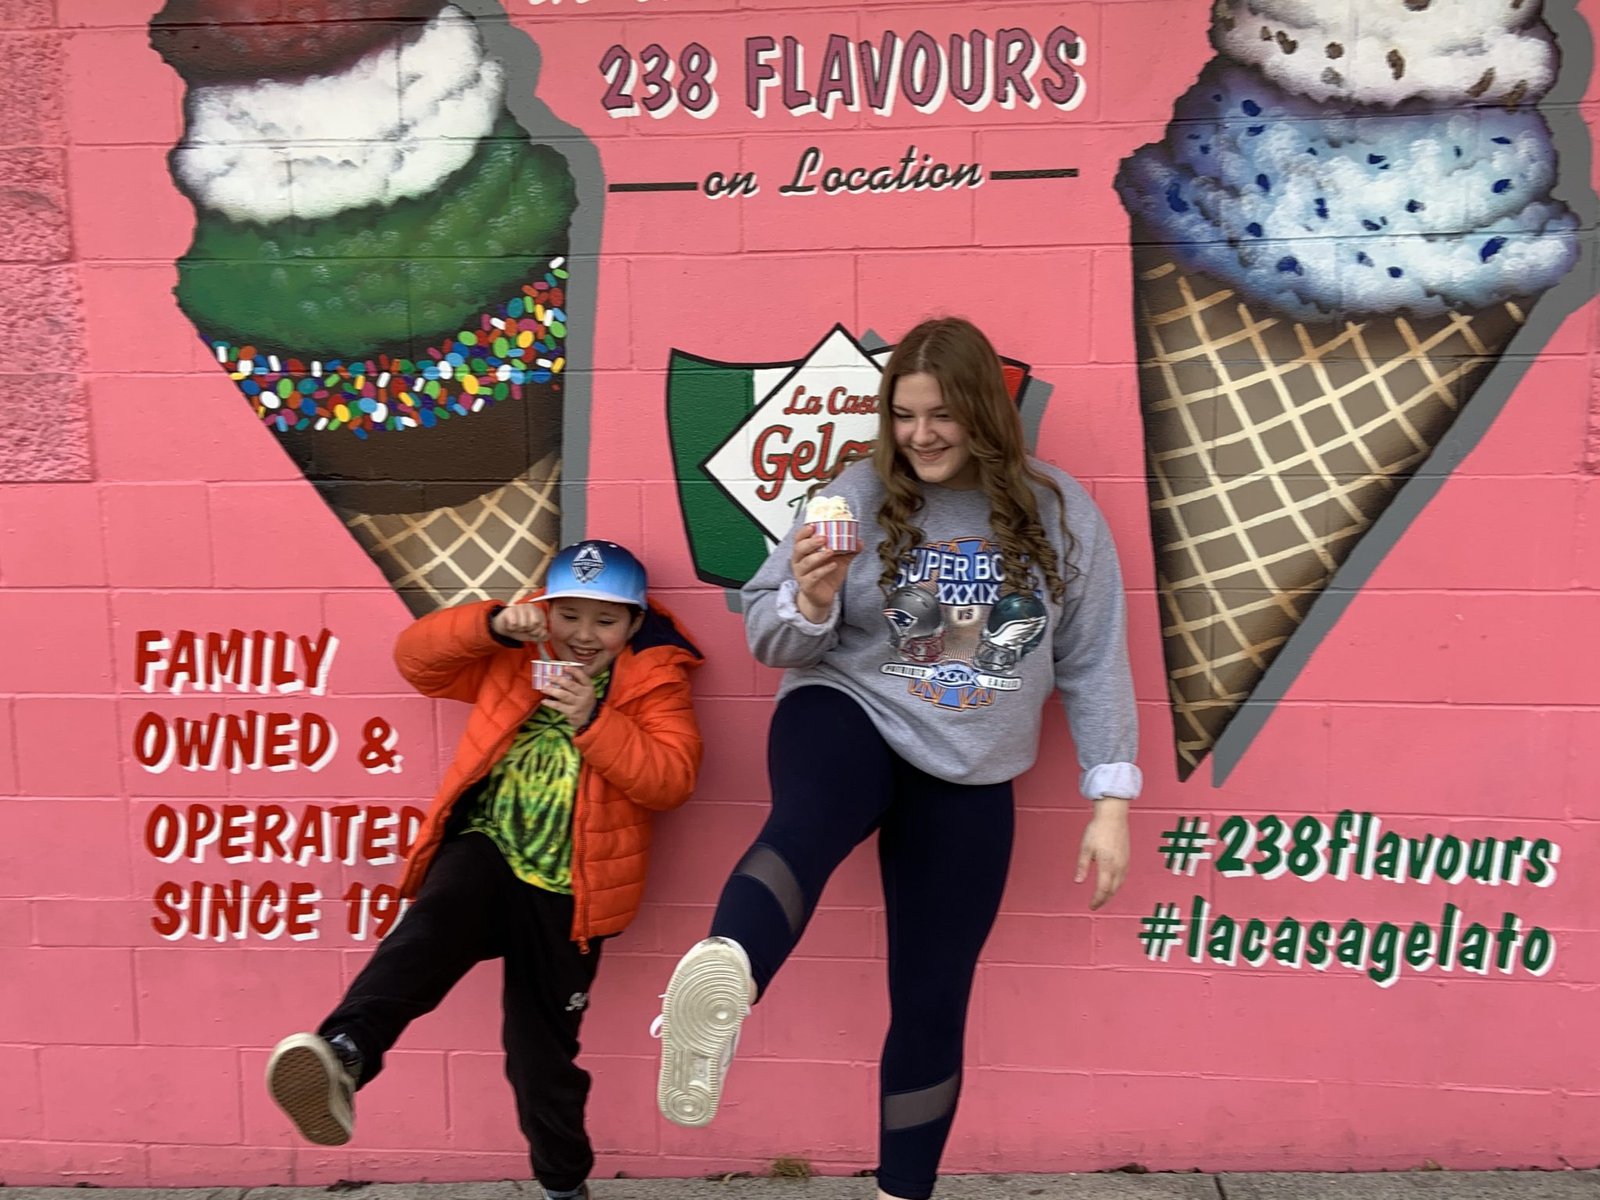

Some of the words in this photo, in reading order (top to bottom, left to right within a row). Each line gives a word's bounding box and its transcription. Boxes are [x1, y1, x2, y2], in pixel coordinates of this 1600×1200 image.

[600, 42, 718, 117] 238
[745, 27, 1086, 117] FLAVOURS
[703, 172, 758, 196] on
[779, 146, 984, 196] Location
[783, 385, 823, 415] La
[752, 421, 876, 502] Gel
[935, 582, 1000, 605] XXXIX
[974, 552, 1006, 582] BO
[134, 628, 338, 695] FAMILY
[133, 709, 337, 773] OWNED
[358, 716, 403, 774] &
[145, 803, 428, 866] OPERATED
[1158, 809, 1560, 887] #238flavours
[152, 879, 321, 941] SINCE
[343, 881, 407, 940] 19
[1138, 895, 1555, 987] #lacasagelato
